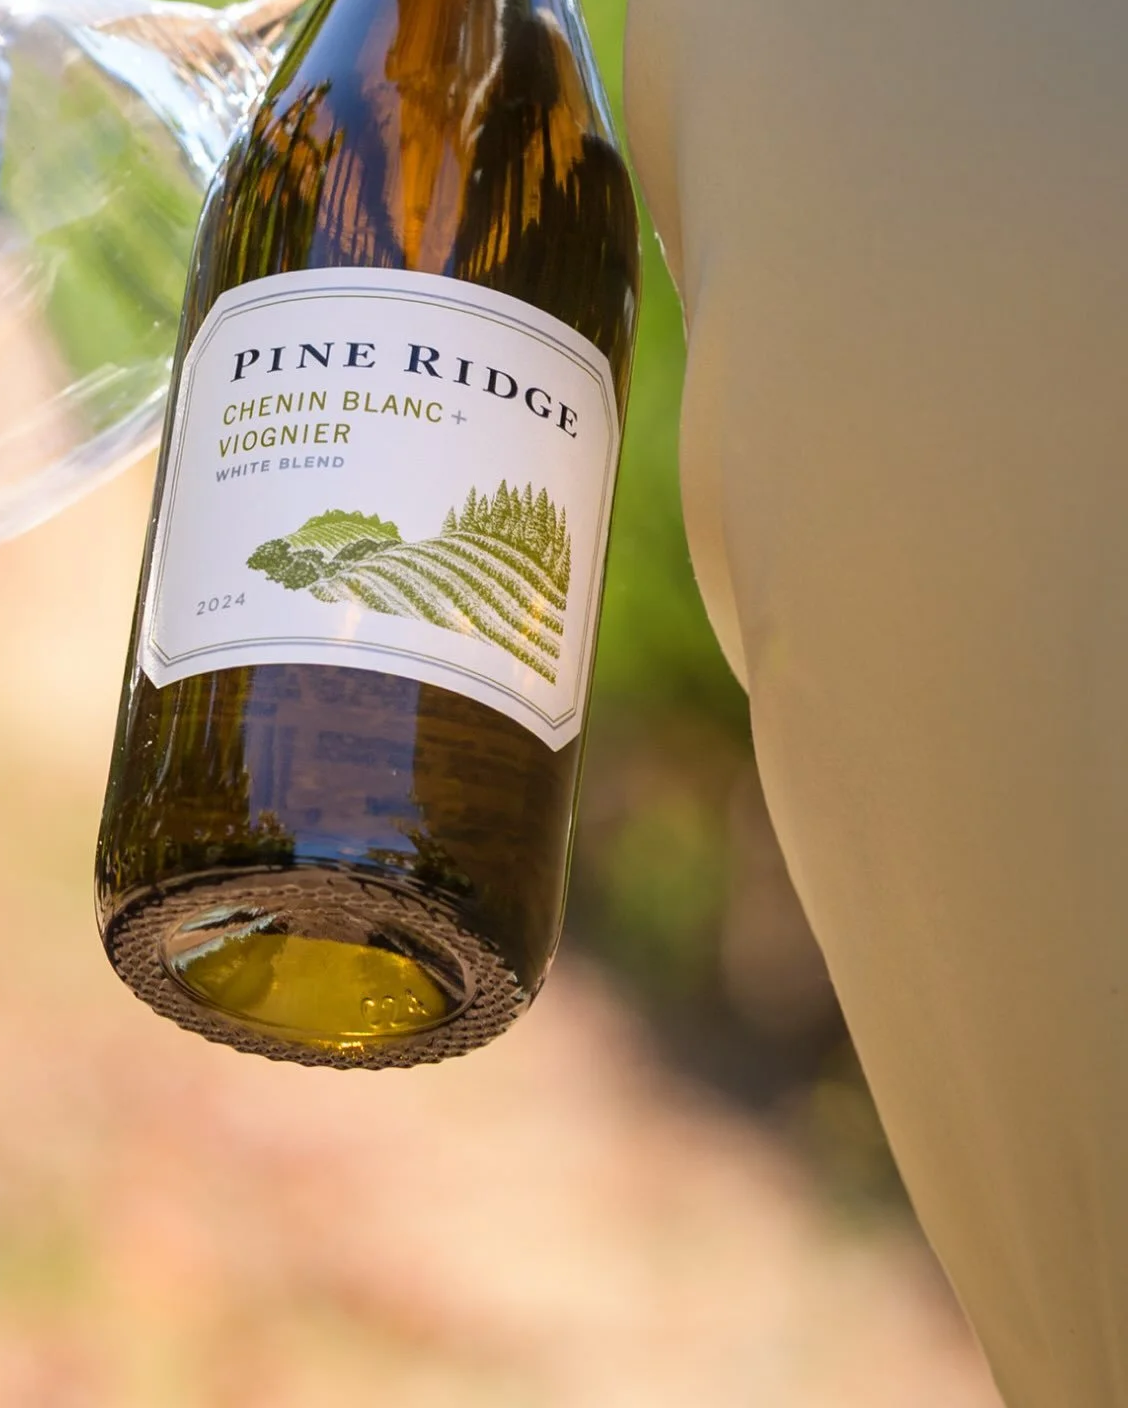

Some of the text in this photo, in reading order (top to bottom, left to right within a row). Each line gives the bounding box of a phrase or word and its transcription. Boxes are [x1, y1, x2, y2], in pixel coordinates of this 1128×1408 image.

[222, 390, 328, 426] CHENIN
[229, 341, 580, 440] PINE RIDGE
[218, 422, 351, 459] VIOGNIER
[214, 455, 345, 484] WHITE BLEND
[196, 592, 246, 616] 2024
